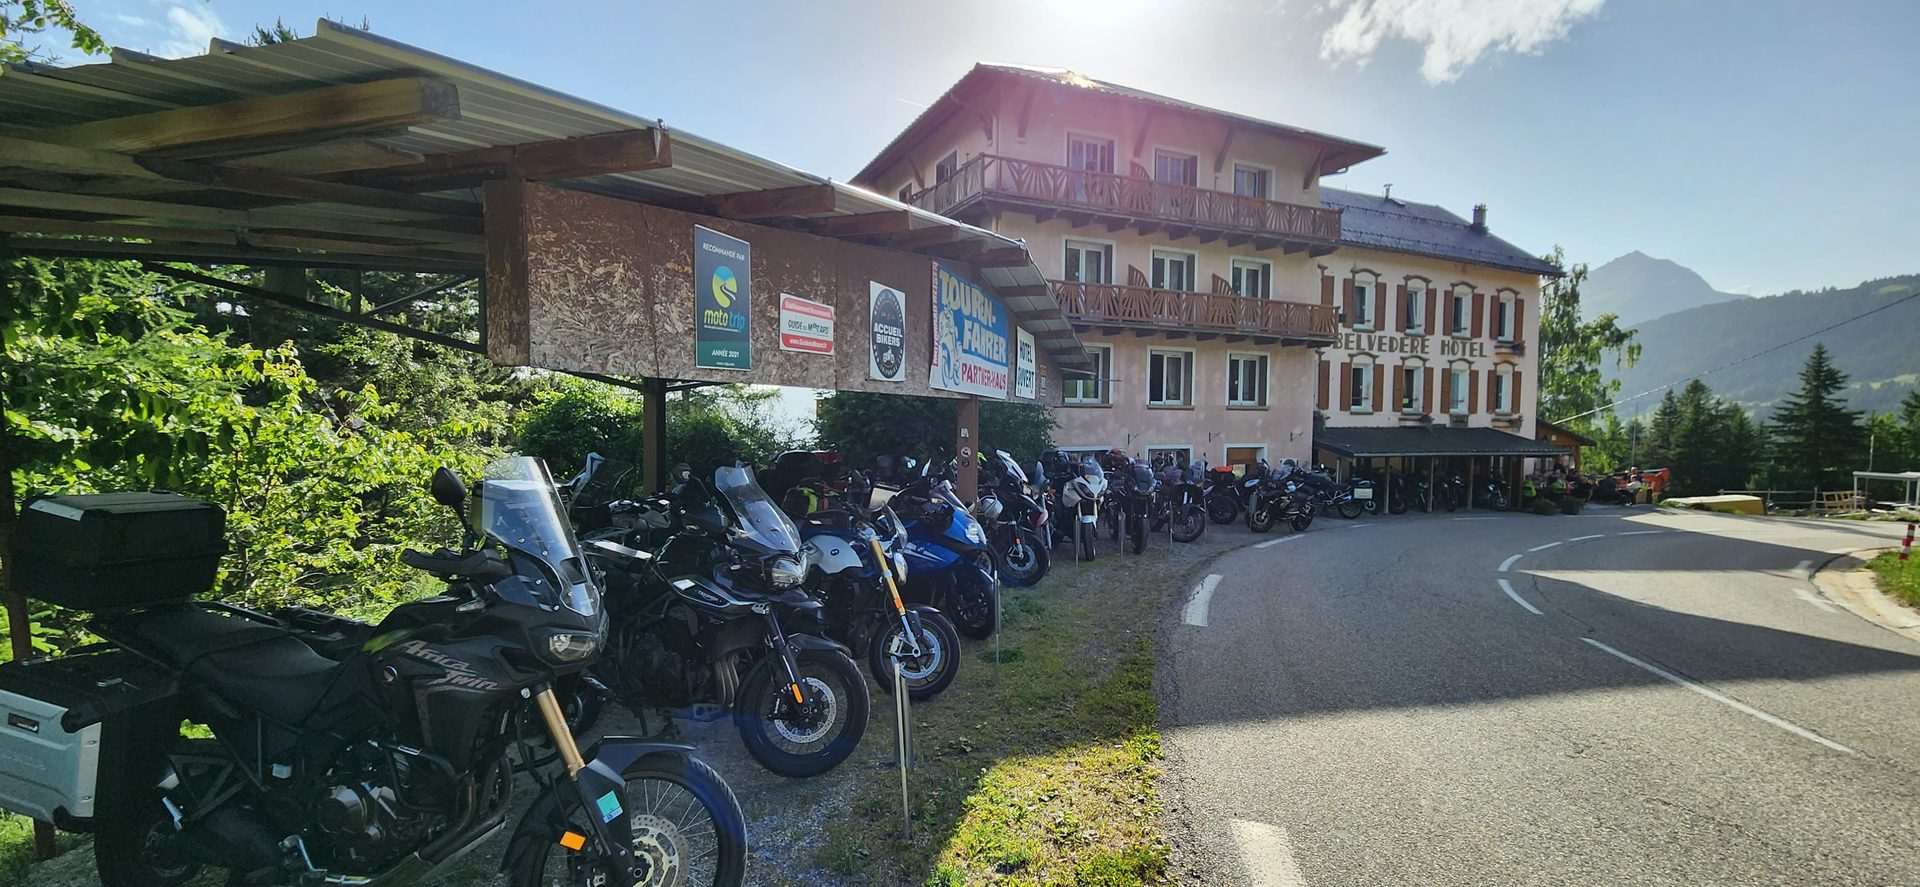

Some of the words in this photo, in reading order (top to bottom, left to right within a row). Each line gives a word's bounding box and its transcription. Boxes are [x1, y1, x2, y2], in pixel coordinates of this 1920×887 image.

[703, 242, 735, 258] RECOMMANDÉ
[736, 251, 745, 260] PAR
[940, 269, 997, 327] TOUREN-
[704, 309, 728, 327] moto
[729, 311, 745, 335] trip
[788, 319, 802, 330] GUIDE
[873, 322, 903, 338] ACCUEIL
[876, 333, 900, 347] BIKERS
[962, 318, 1007, 363] FAHRER
[1332, 332, 1430, 354] BELVEDERE
[1440, 339, 1487, 358] HOTEL
[711, 347, 728, 357] ANNÉE
[728, 350, 739, 358] 2021
[961, 362, 1007, 391] PARTNER-HAUS
[1018, 366, 1034, 389] OUVERT
[392, 640, 476, 673] Africa
[426, 669, 499, 690] Twin
